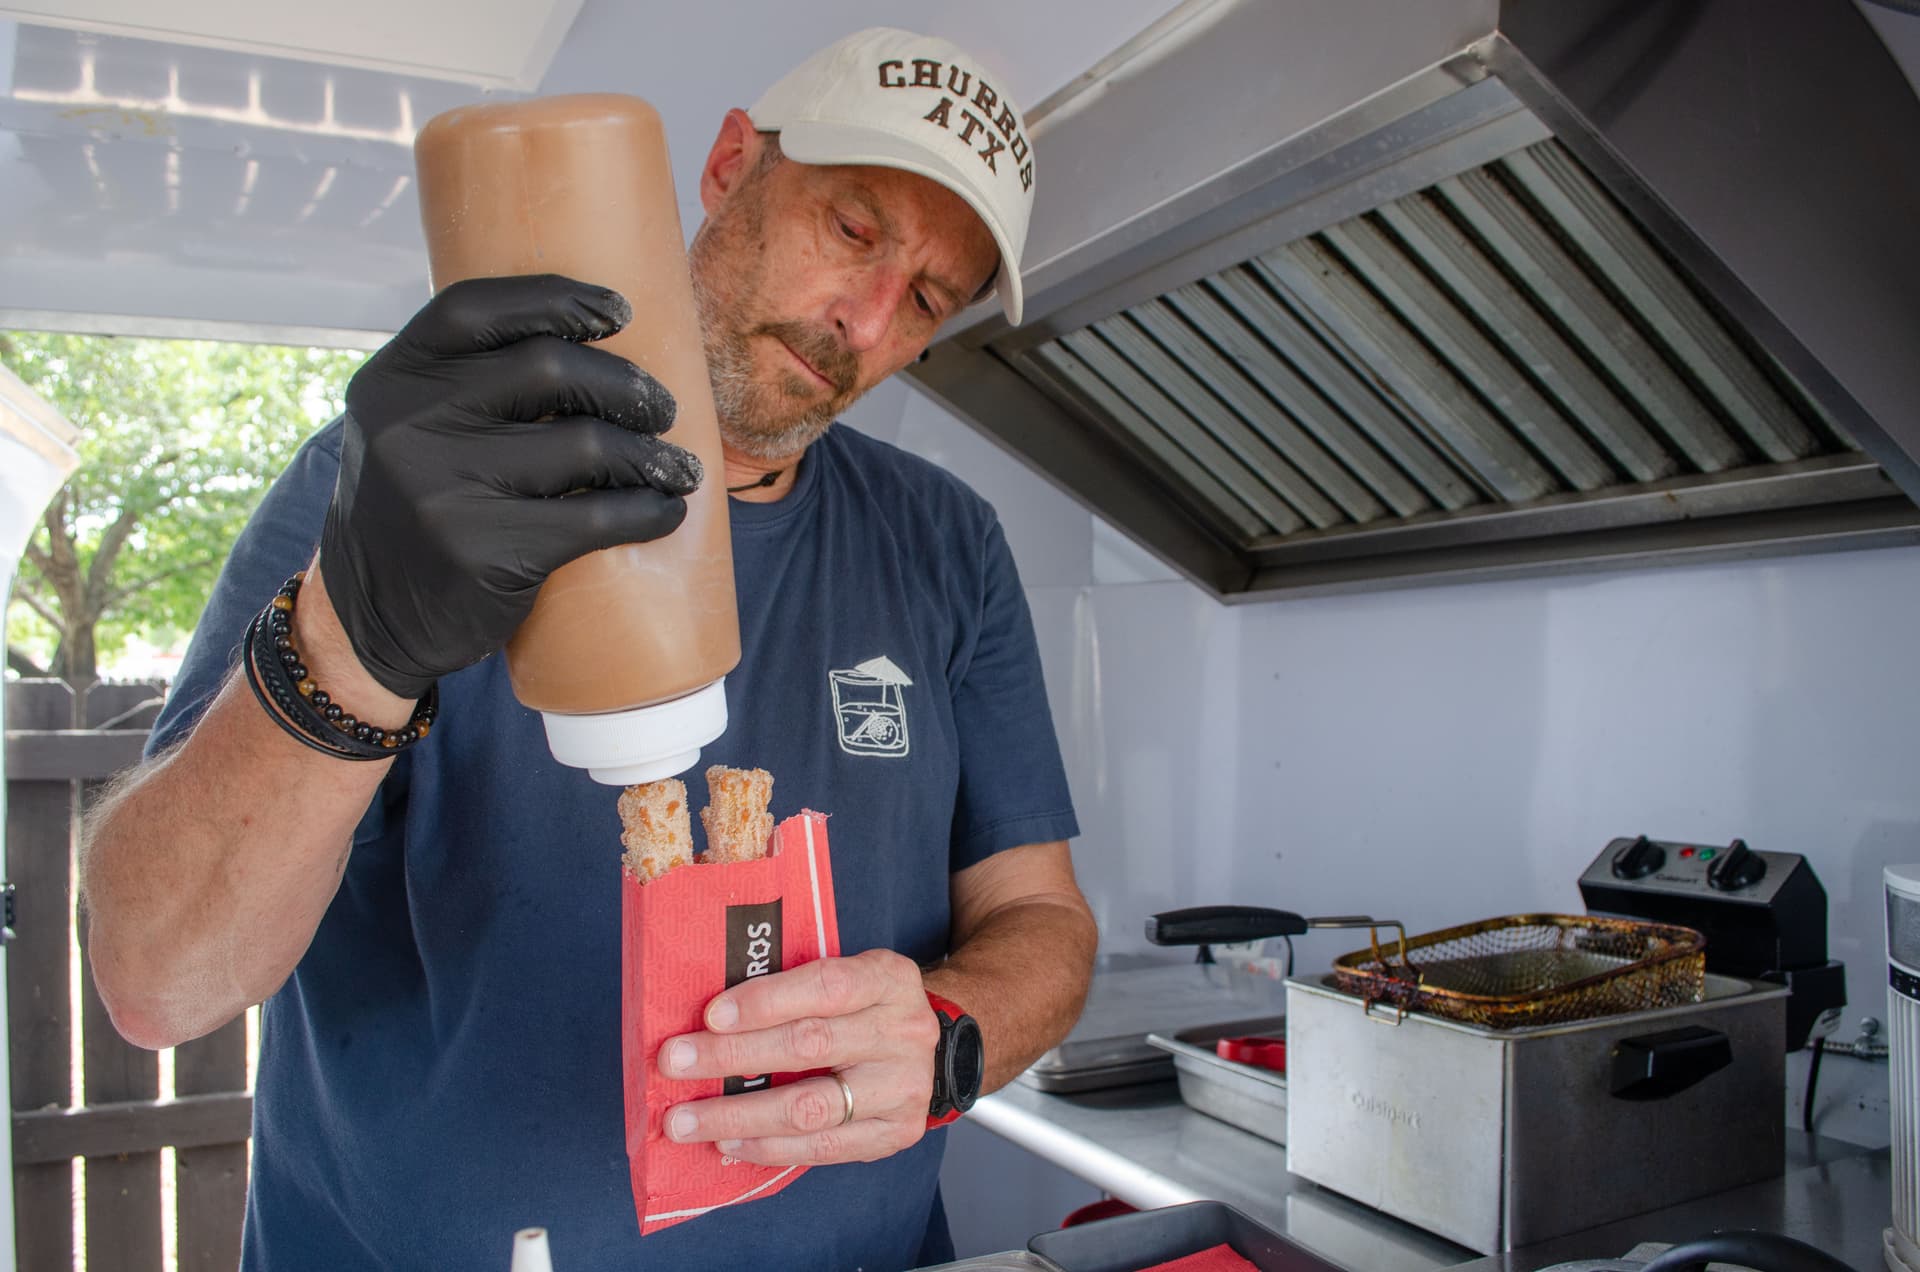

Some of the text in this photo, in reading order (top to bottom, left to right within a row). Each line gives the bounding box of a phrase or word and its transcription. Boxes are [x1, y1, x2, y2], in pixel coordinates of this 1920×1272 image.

[878, 59, 1033, 193] CHURROS
[923, 97, 1006, 176] ATX
[746, 922, 772, 978] ROS
